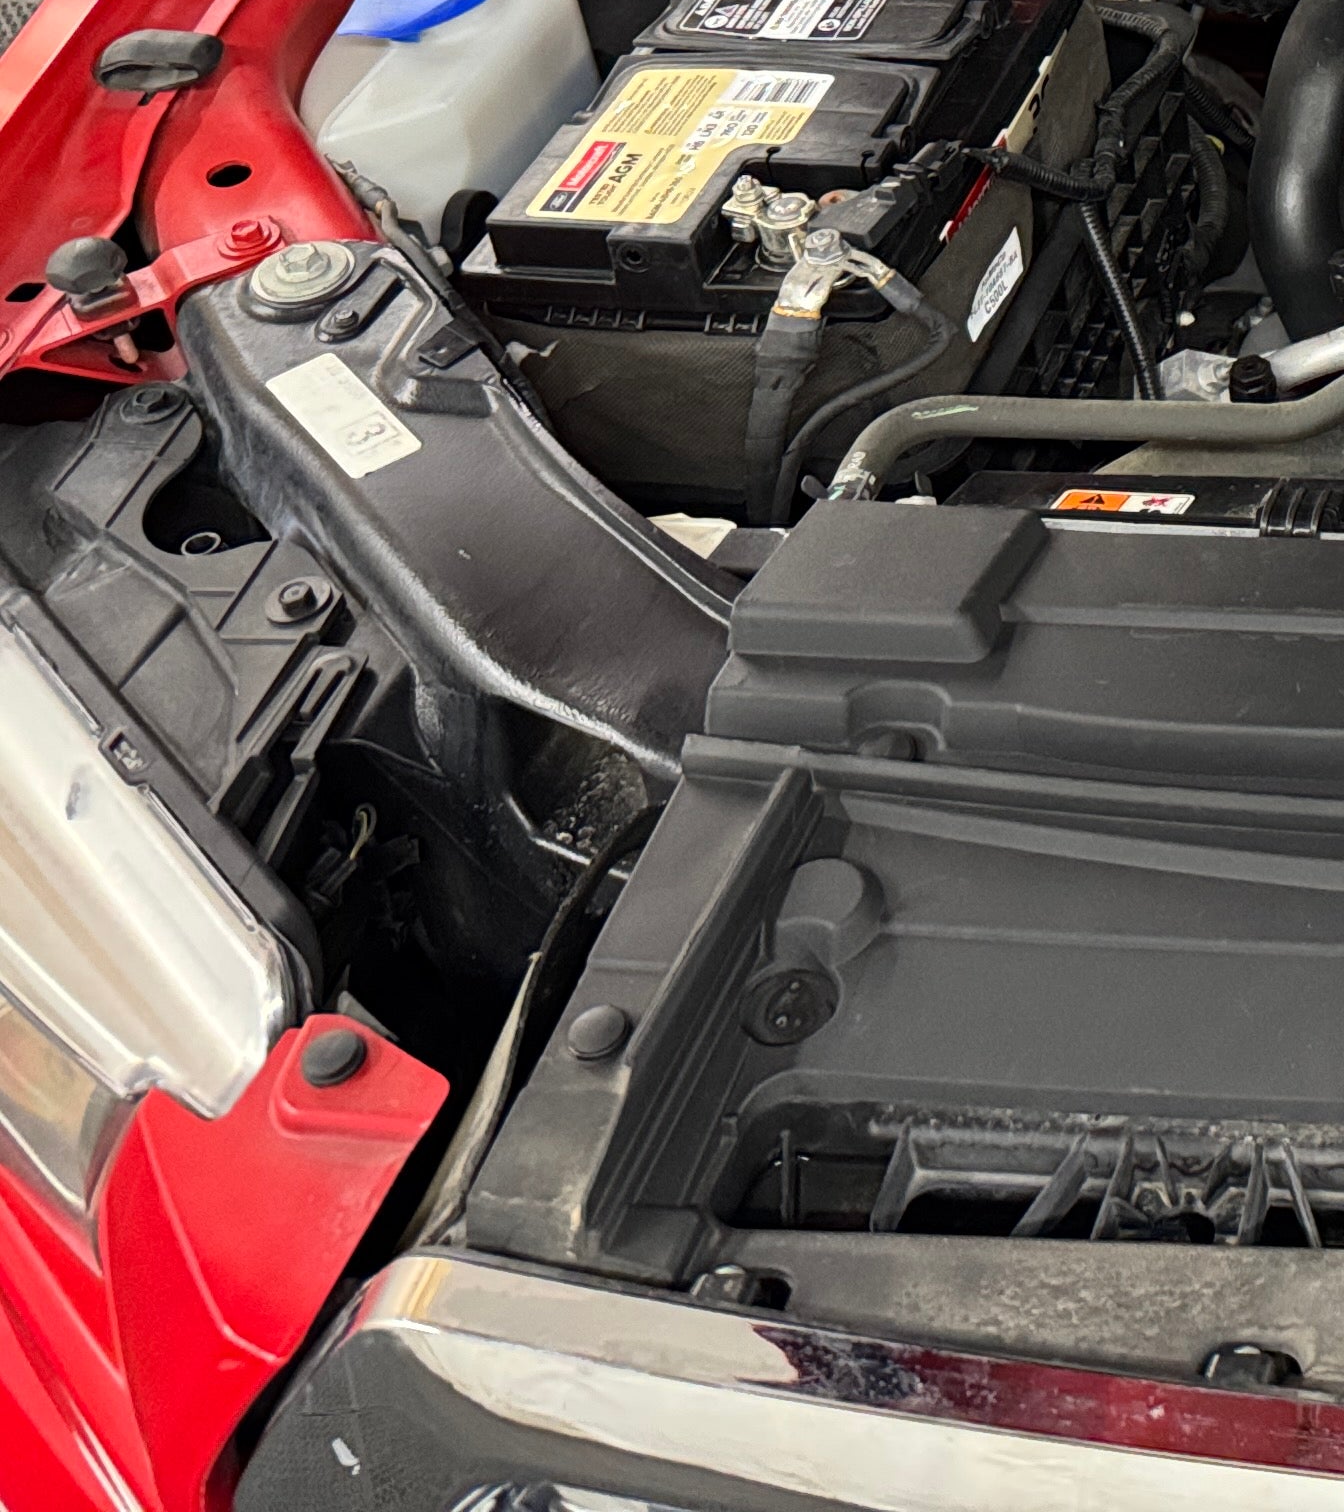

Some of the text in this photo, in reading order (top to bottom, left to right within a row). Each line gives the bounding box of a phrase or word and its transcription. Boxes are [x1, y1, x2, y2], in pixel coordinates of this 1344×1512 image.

[567, 145, 610, 185] Motorcraft
[610, 153, 643, 183] AGM
[587, 183, 610, 204] TESTED
